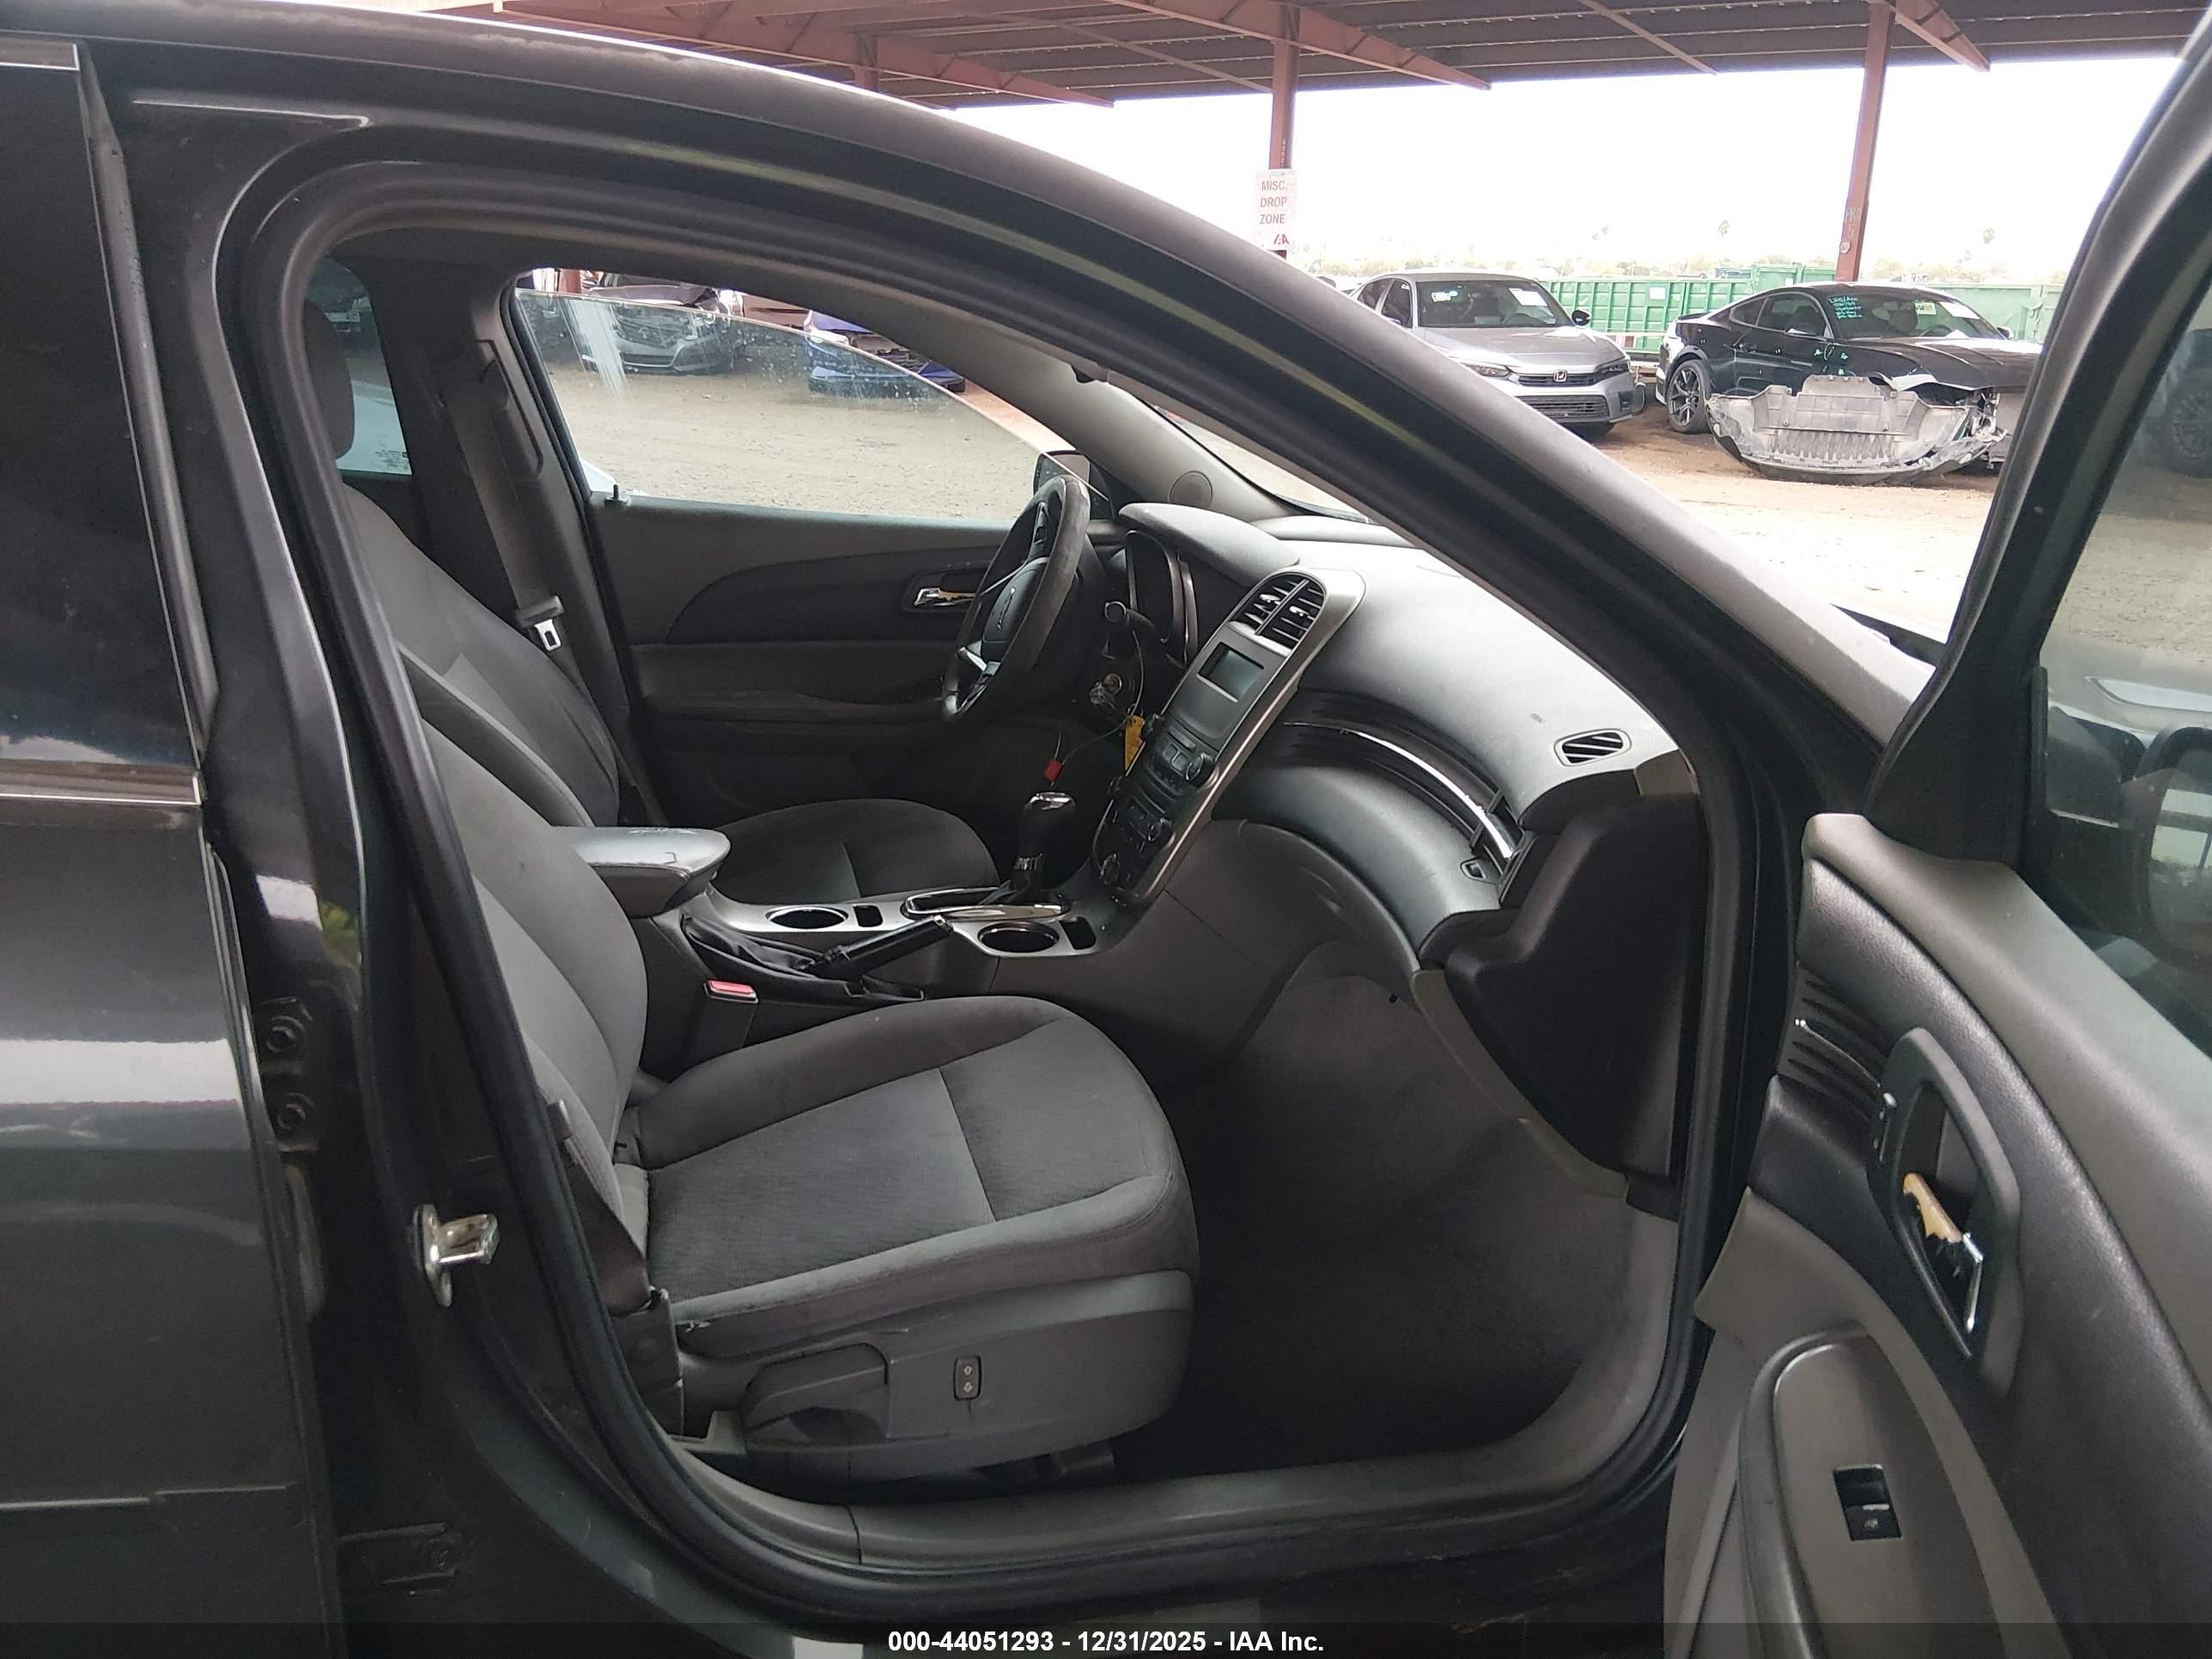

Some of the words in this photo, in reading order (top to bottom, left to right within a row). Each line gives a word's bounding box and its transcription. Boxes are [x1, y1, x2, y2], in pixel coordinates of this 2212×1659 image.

[1261, 180, 1288, 191] MISC.
[1260, 197, 1287, 208] DROP
[1259, 214, 1285, 224] ZONE
